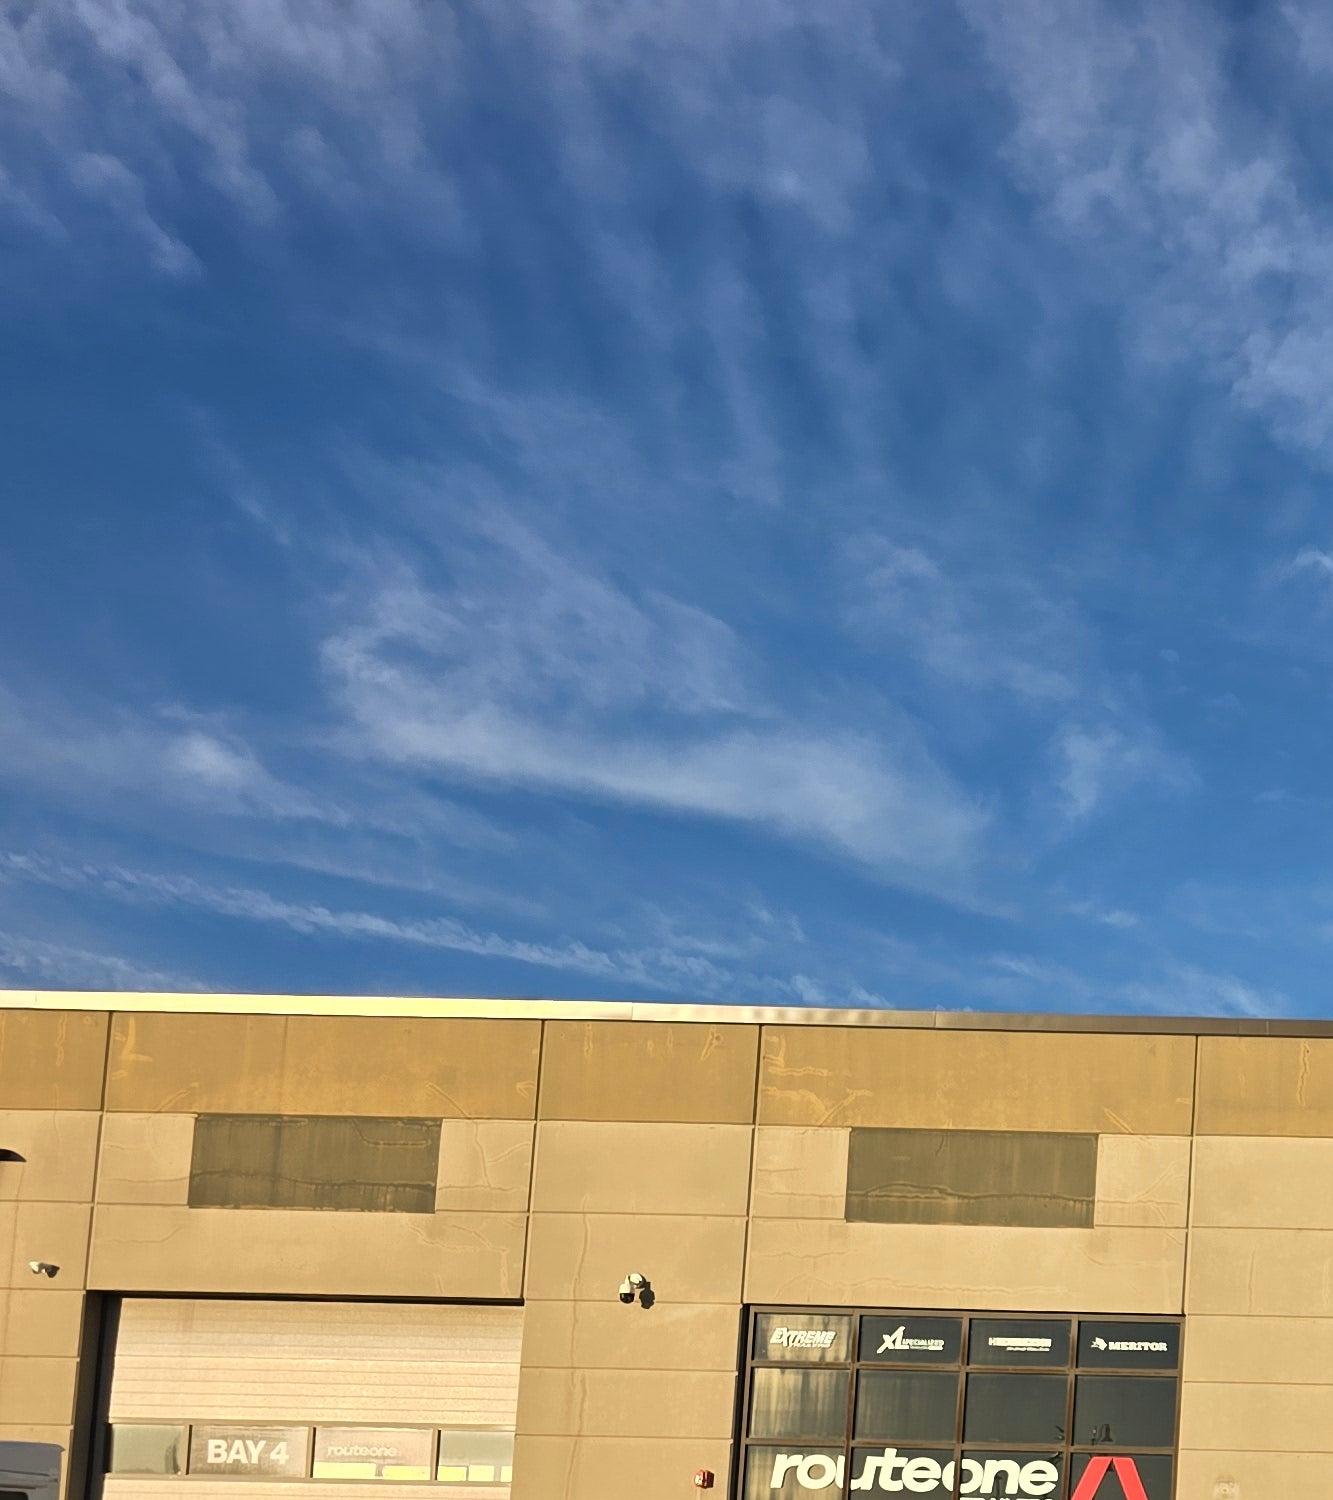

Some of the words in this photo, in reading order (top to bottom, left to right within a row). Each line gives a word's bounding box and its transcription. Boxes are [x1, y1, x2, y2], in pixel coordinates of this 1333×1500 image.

[770, 1327, 837, 1347] EXTREME
[876, 1325, 909, 1354] XL
[1108, 1341, 1168, 1352] MERITOR
[206, 1439, 266, 1464] BAY
[269, 1441, 290, 1465] 4
[327, 1443, 398, 1457] routeone
[770, 1447, 1059, 1496] routeone
